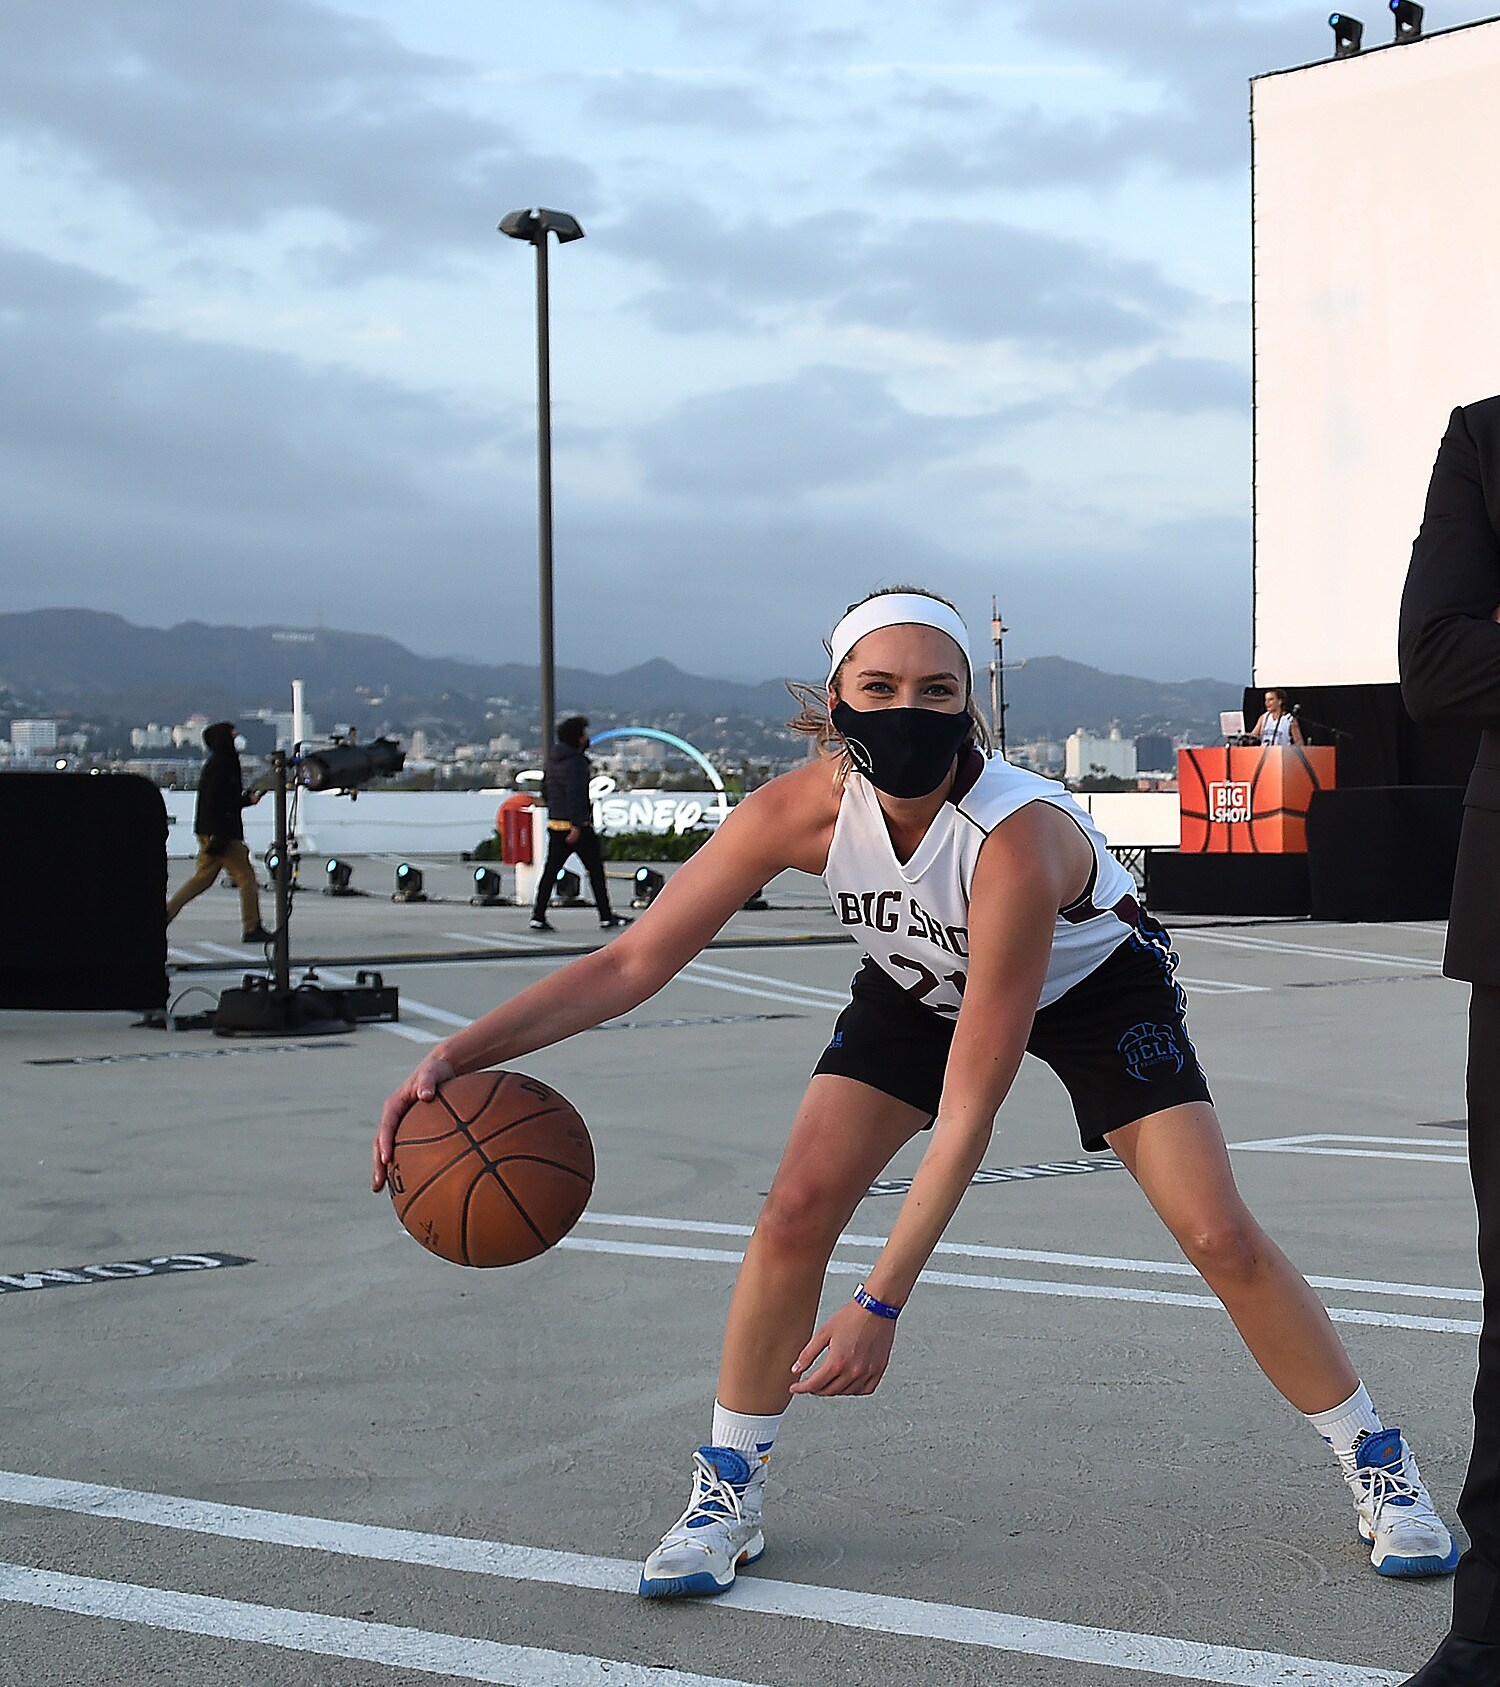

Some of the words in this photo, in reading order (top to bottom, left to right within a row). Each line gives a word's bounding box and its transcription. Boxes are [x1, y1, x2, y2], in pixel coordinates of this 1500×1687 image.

[1216, 787, 1244, 807] BIG
[1214, 807, 1247, 823] SHOT
[838, 890, 902, 933] BIG
[907, 898, 970, 958] SHO
[1125, 1041, 1180, 1065] UCLA
